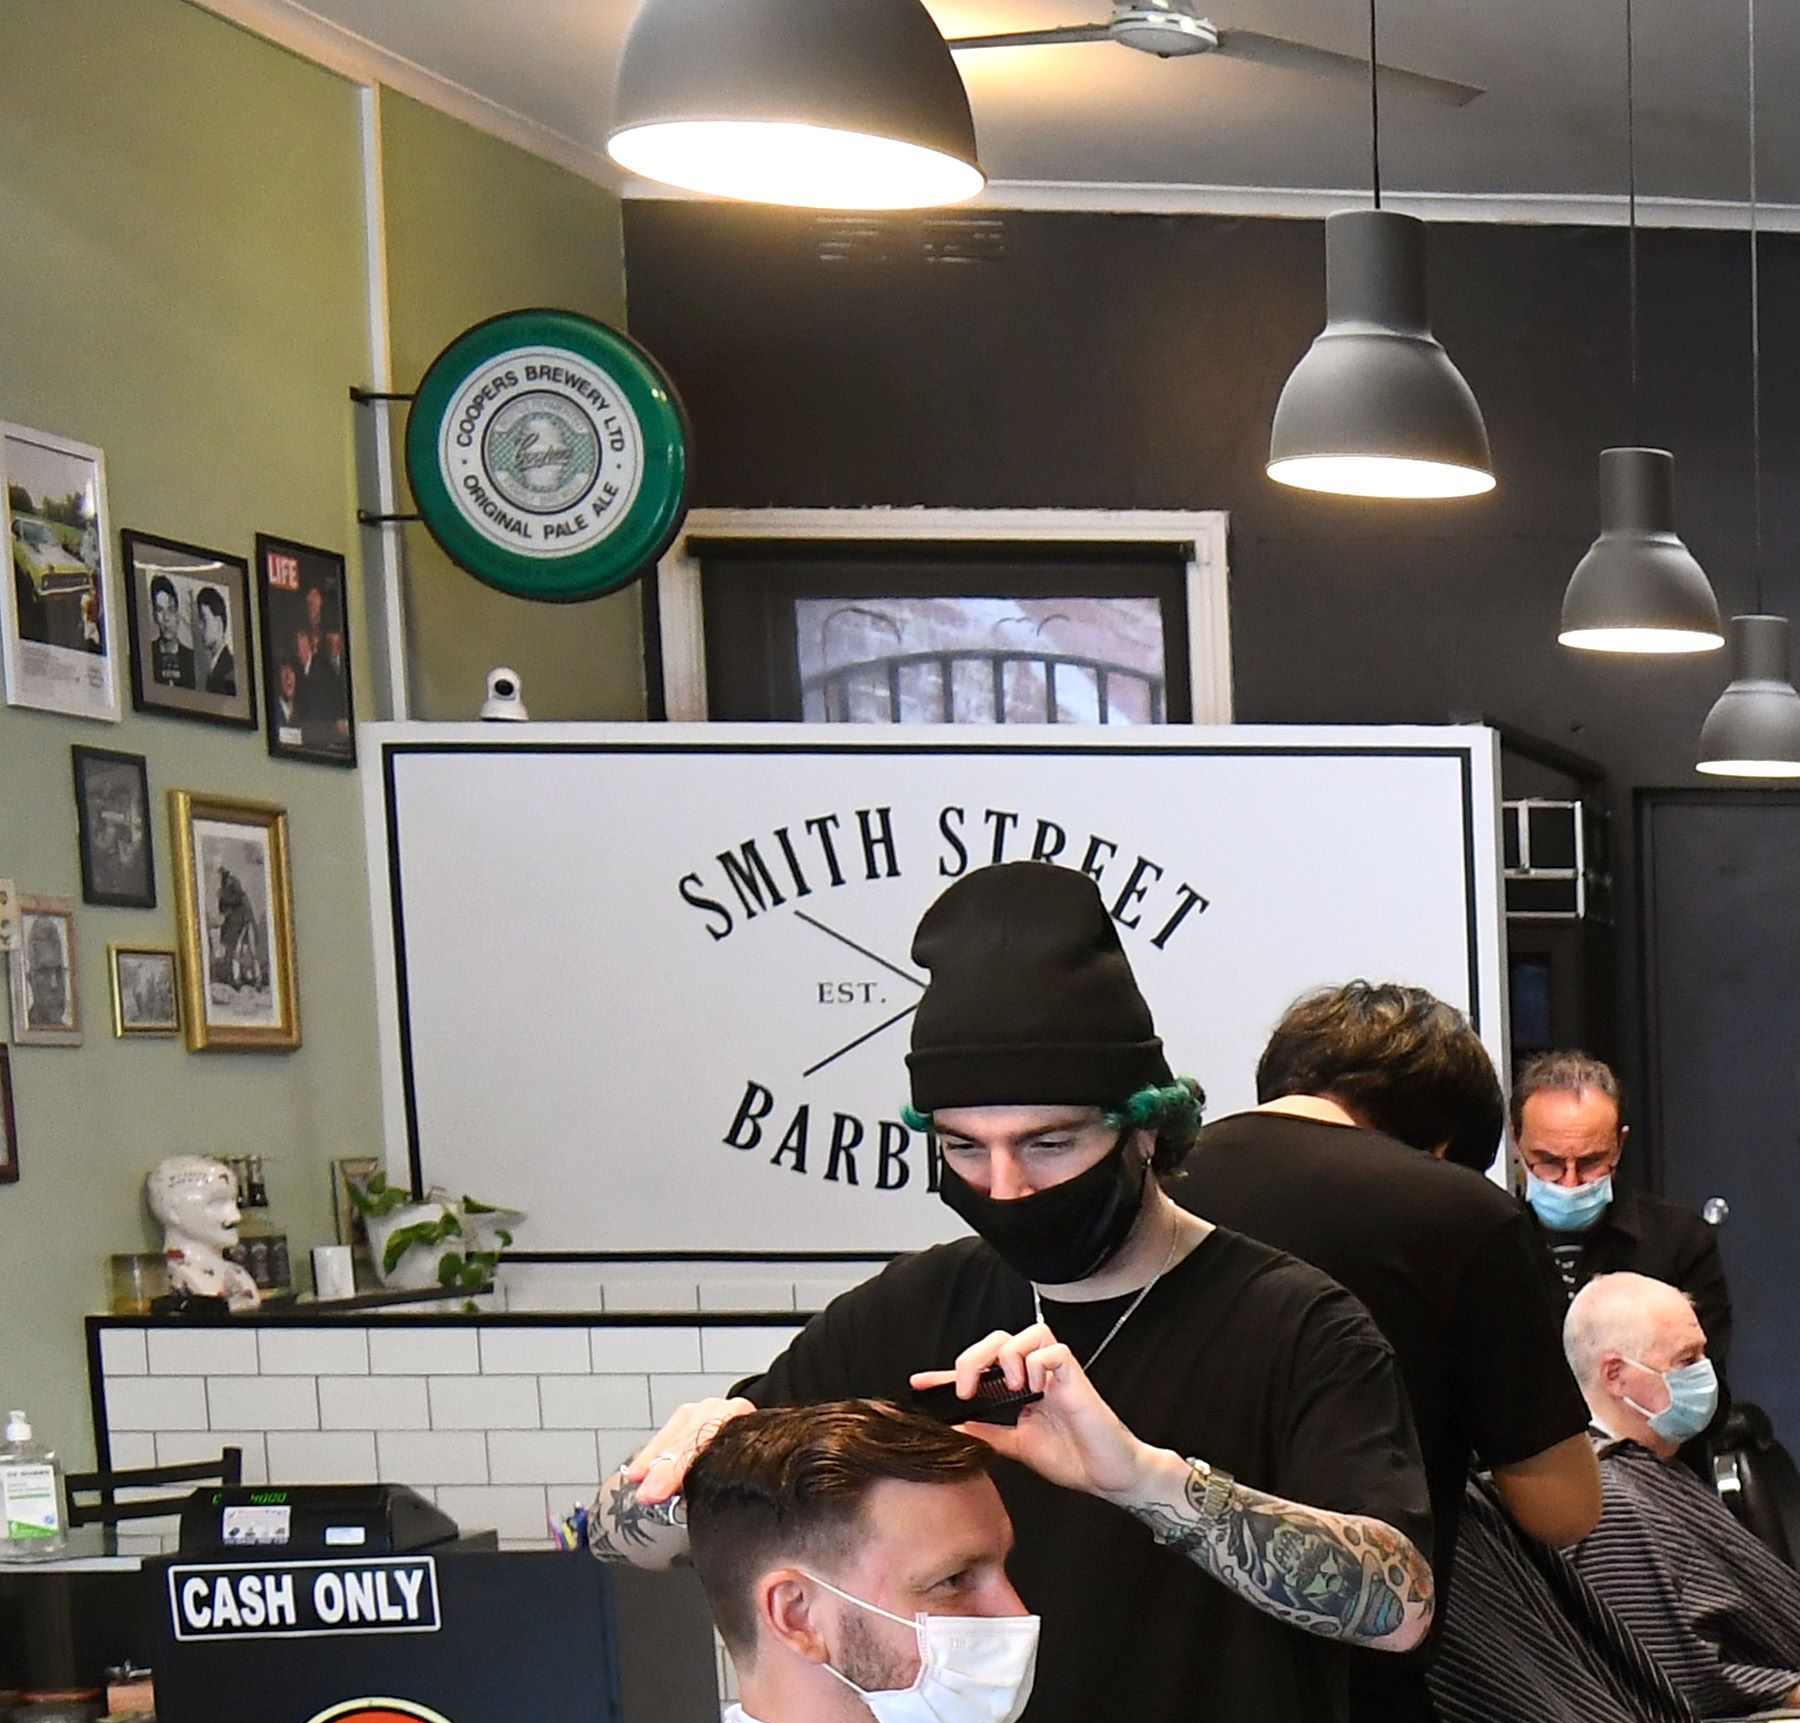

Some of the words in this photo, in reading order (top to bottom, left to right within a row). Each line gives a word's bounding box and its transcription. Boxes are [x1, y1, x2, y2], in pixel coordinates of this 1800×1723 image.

[456, 369, 520, 448] COOPERS
[525, 366, 610, 414] BREWERY
[603, 415, 627, 453] LTD
[462, 474, 532, 540] ORIGINAL
[543, 515, 590, 540] PALE
[592, 483, 620, 518] ALE
[268, 554, 299, 590] LIFE
[678, 806, 901, 942] SMITH
[816, 981, 887, 1004] EST.
[722, 1080, 942, 1194] BARB
[182, 1573, 297, 1629] CASH
[313, 1568, 425, 1624] ONLY
